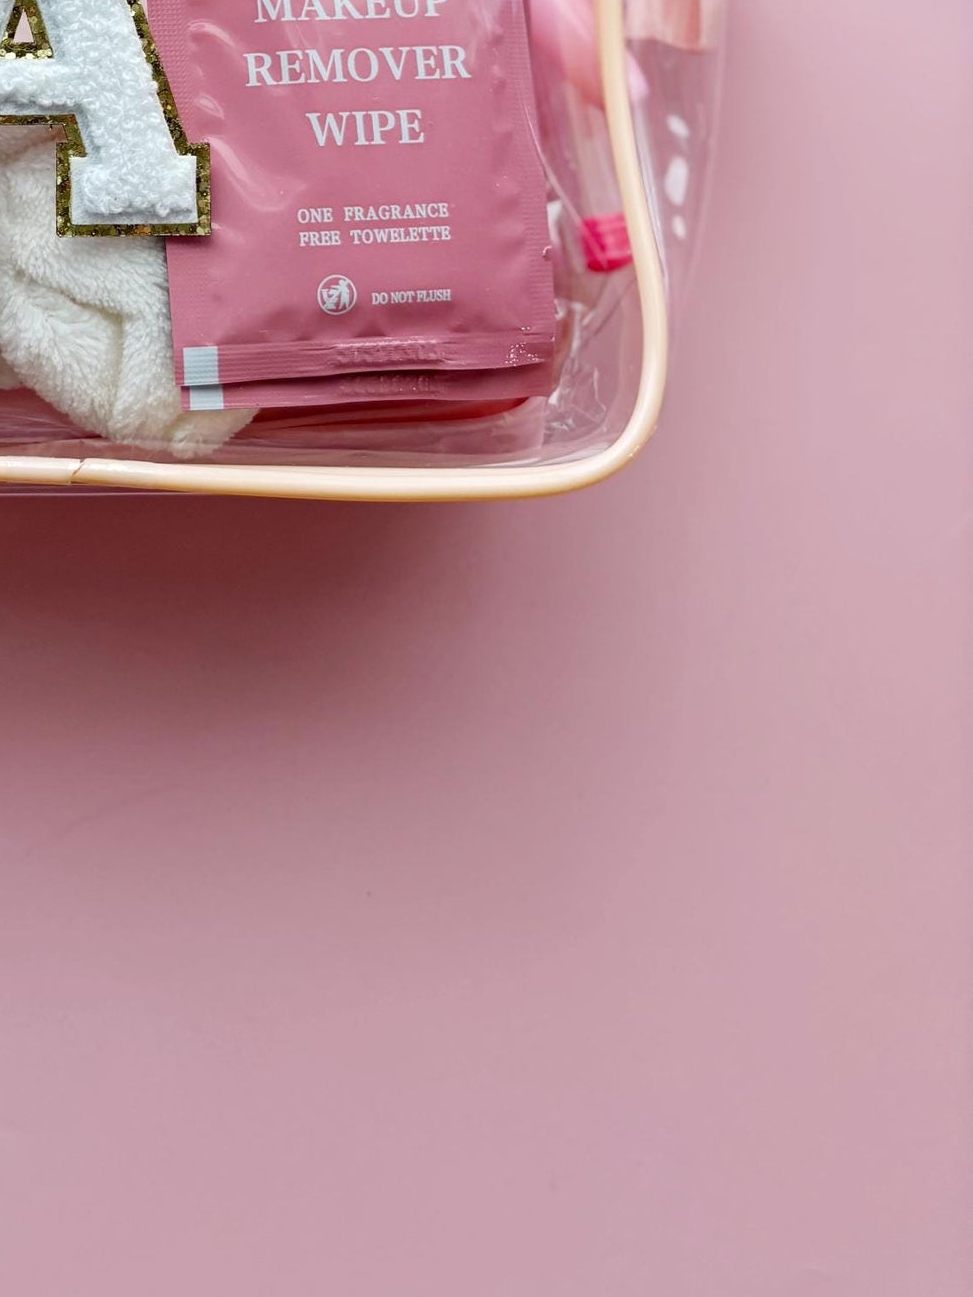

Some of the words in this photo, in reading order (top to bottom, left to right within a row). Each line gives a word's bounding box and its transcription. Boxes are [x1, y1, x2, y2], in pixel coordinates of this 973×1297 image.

[243, 45, 472, 87] REMOVER
[305, 109, 425, 148] WIPE
[297, 207, 333, 224] ONE
[343, 203, 449, 223] FRAGRANCE
[299, 230, 341, 247] FREE
[350, 226, 451, 246] TOWELETTE
[371, 293, 388, 305] DO
[390, 291, 414, 304] NOT
[416, 289, 452, 304] FLUSH
